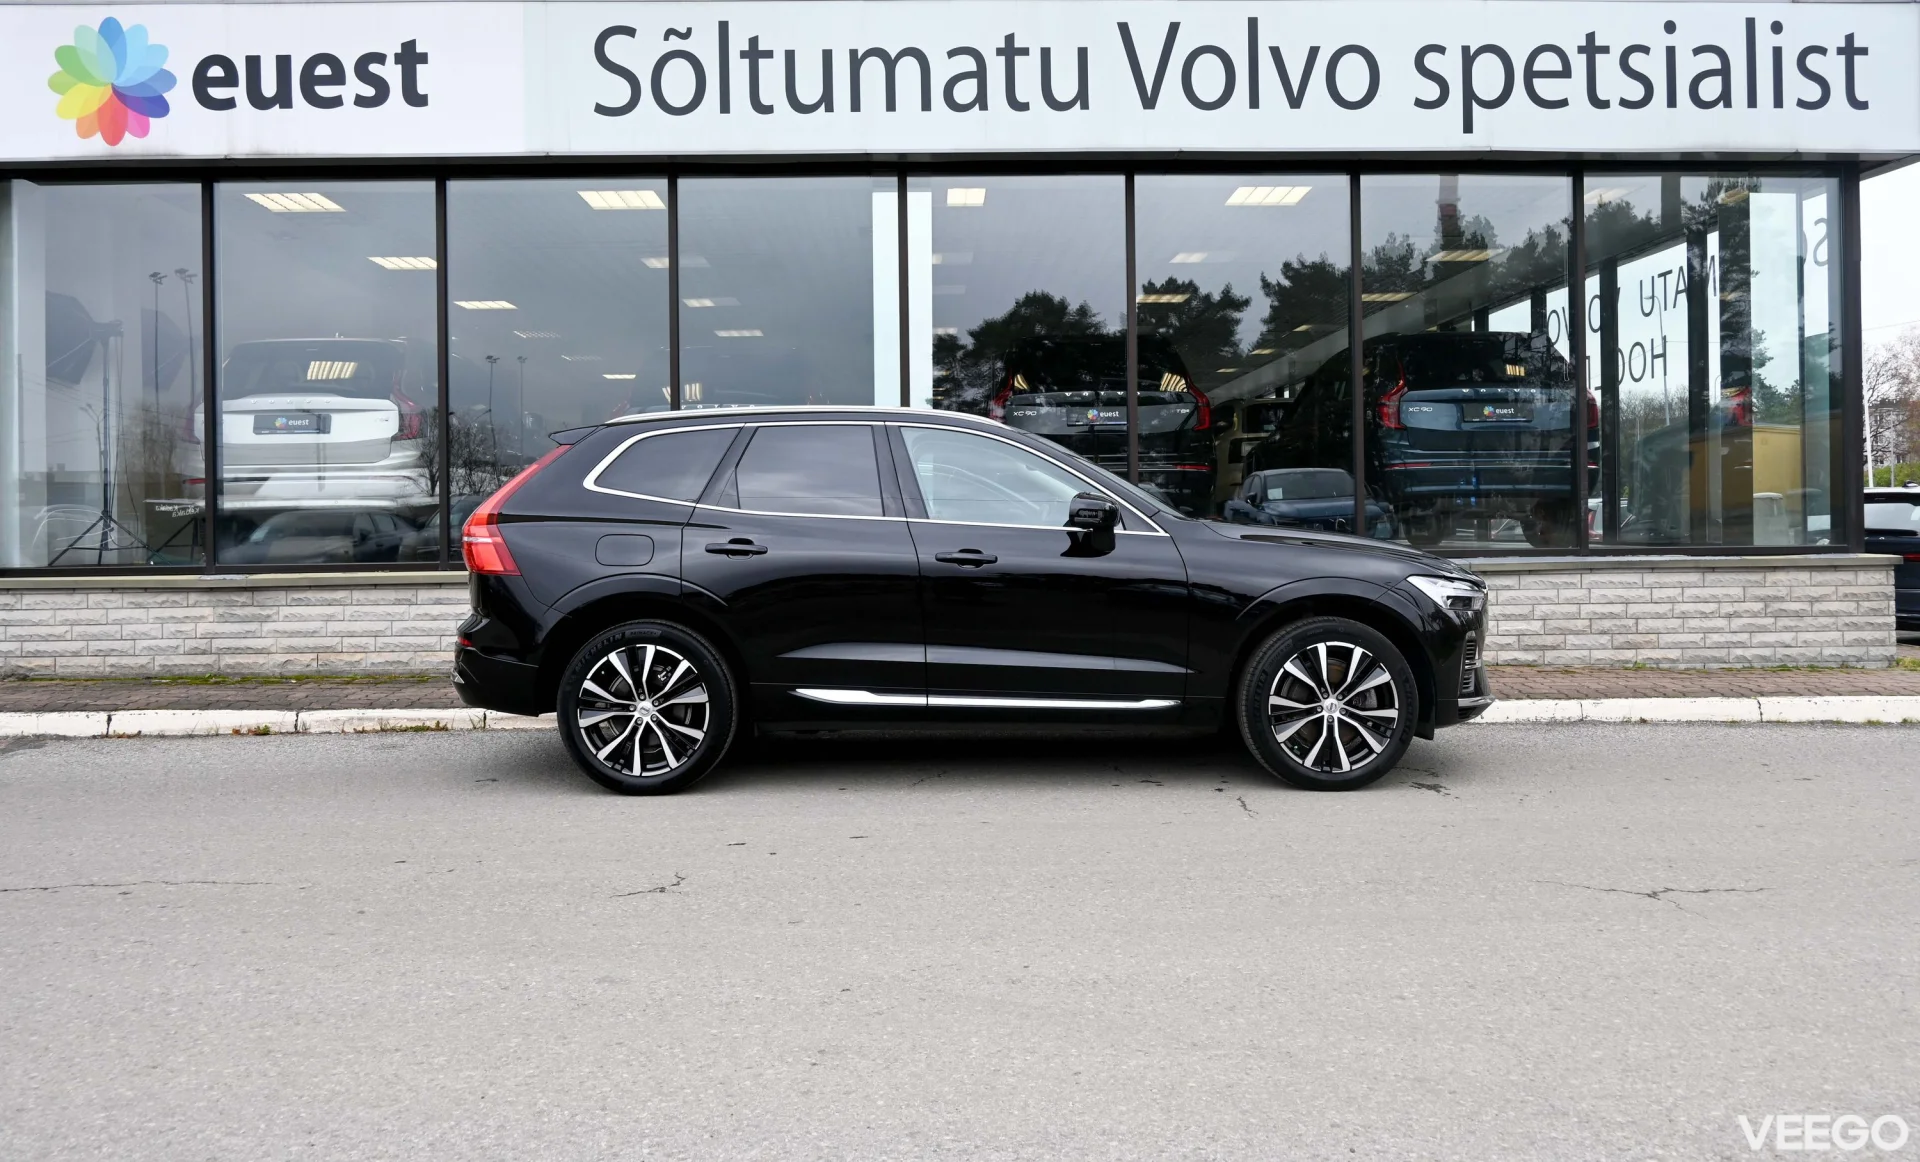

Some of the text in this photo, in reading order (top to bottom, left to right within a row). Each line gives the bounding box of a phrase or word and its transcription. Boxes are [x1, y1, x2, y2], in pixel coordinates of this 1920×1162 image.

[192, 39, 429, 111] euest
[593, 17, 1869, 134] Sõltumatu Volvo spetsialist
[288, 418, 310, 426] euest
[574, 632, 624, 673] MICHELIN
